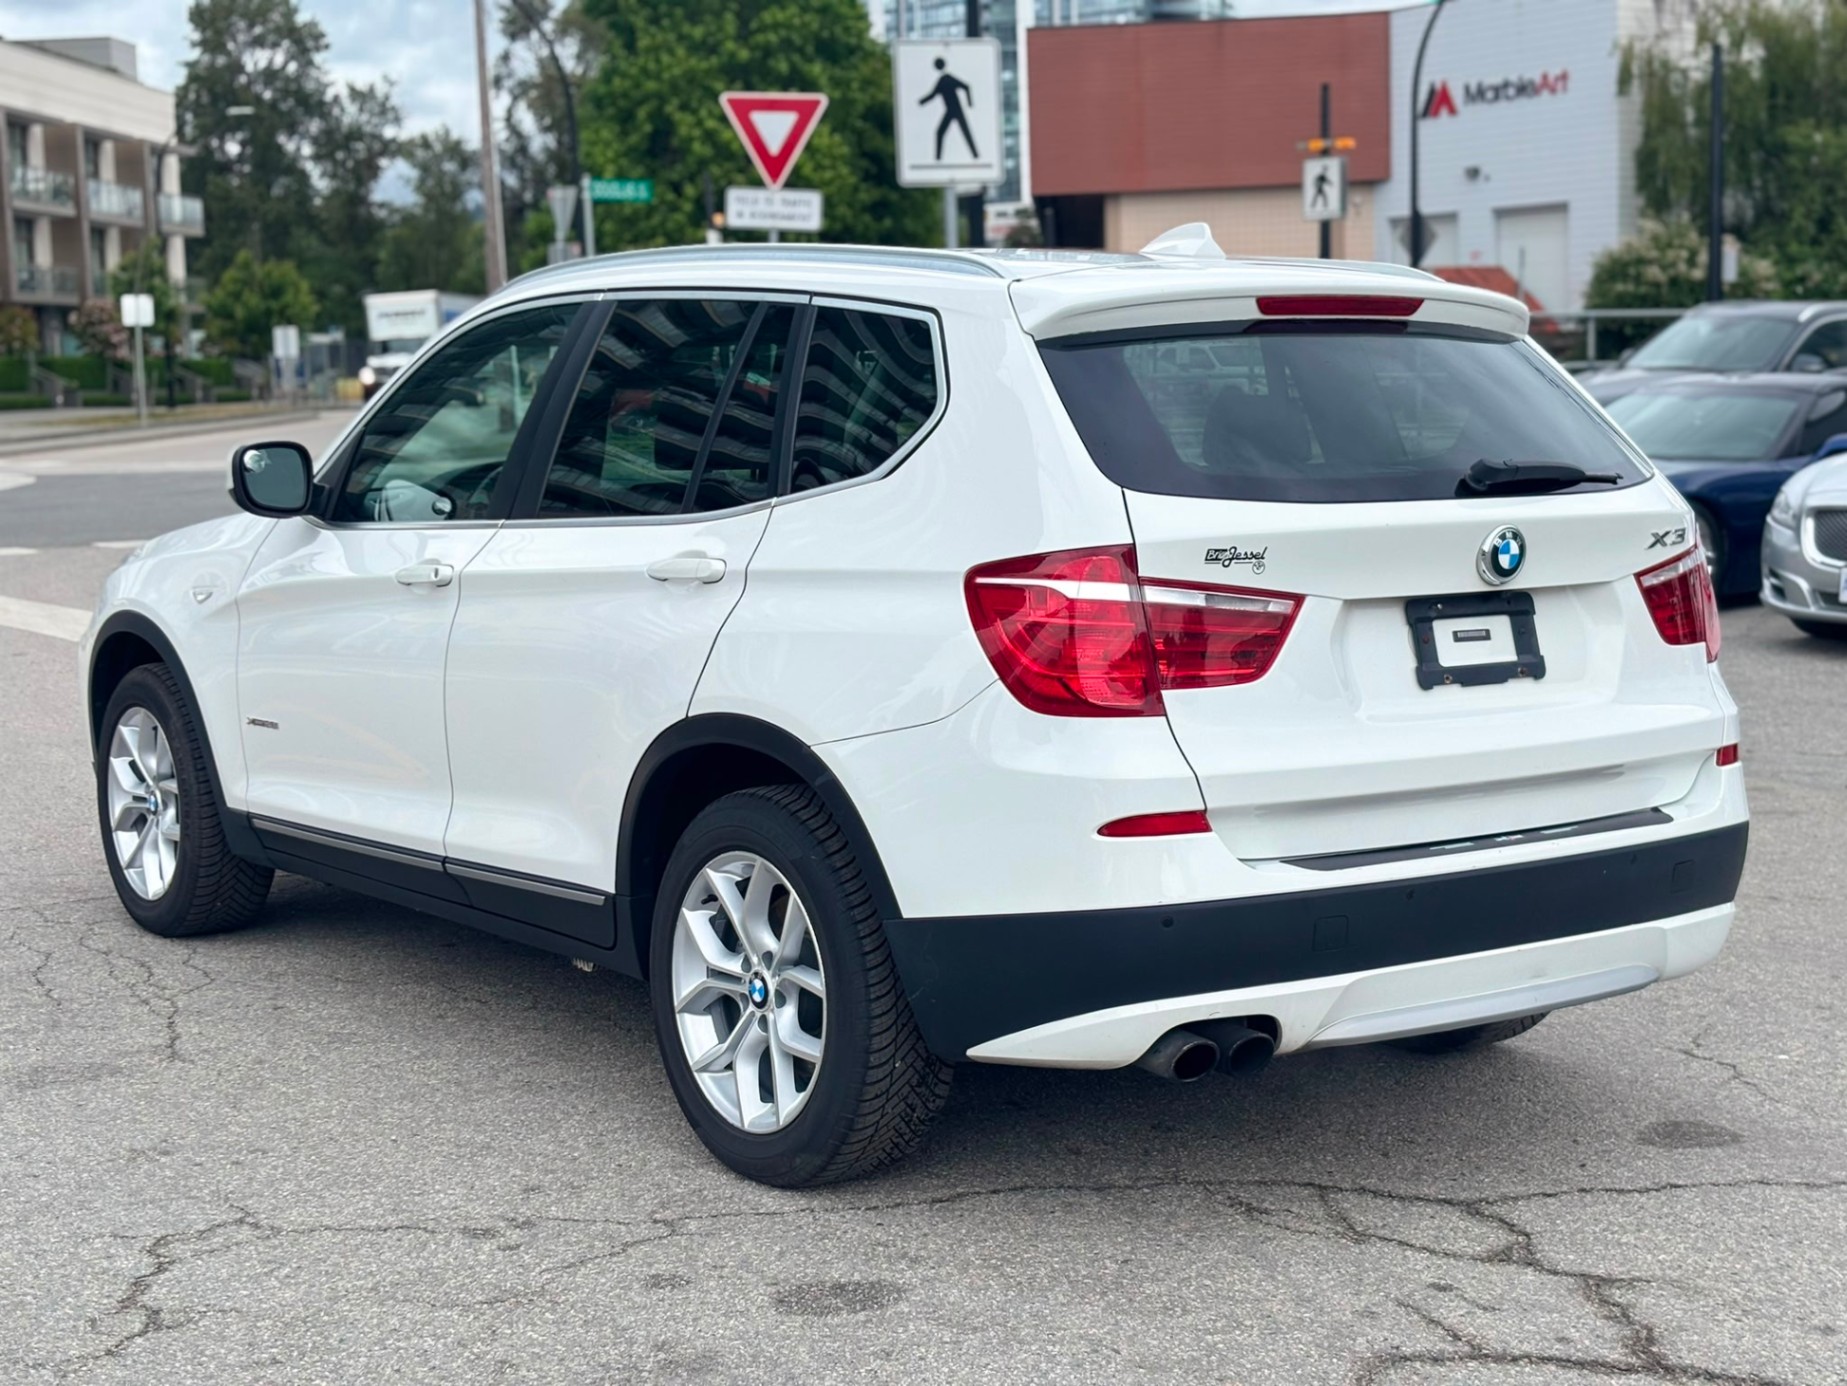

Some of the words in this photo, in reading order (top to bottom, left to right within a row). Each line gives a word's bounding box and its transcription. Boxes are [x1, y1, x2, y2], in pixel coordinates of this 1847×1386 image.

[1463, 68, 1569, 105] MarbleArt
[1645, 527, 1686, 550] X3
[1222, 546, 1268, 568] Jessel
